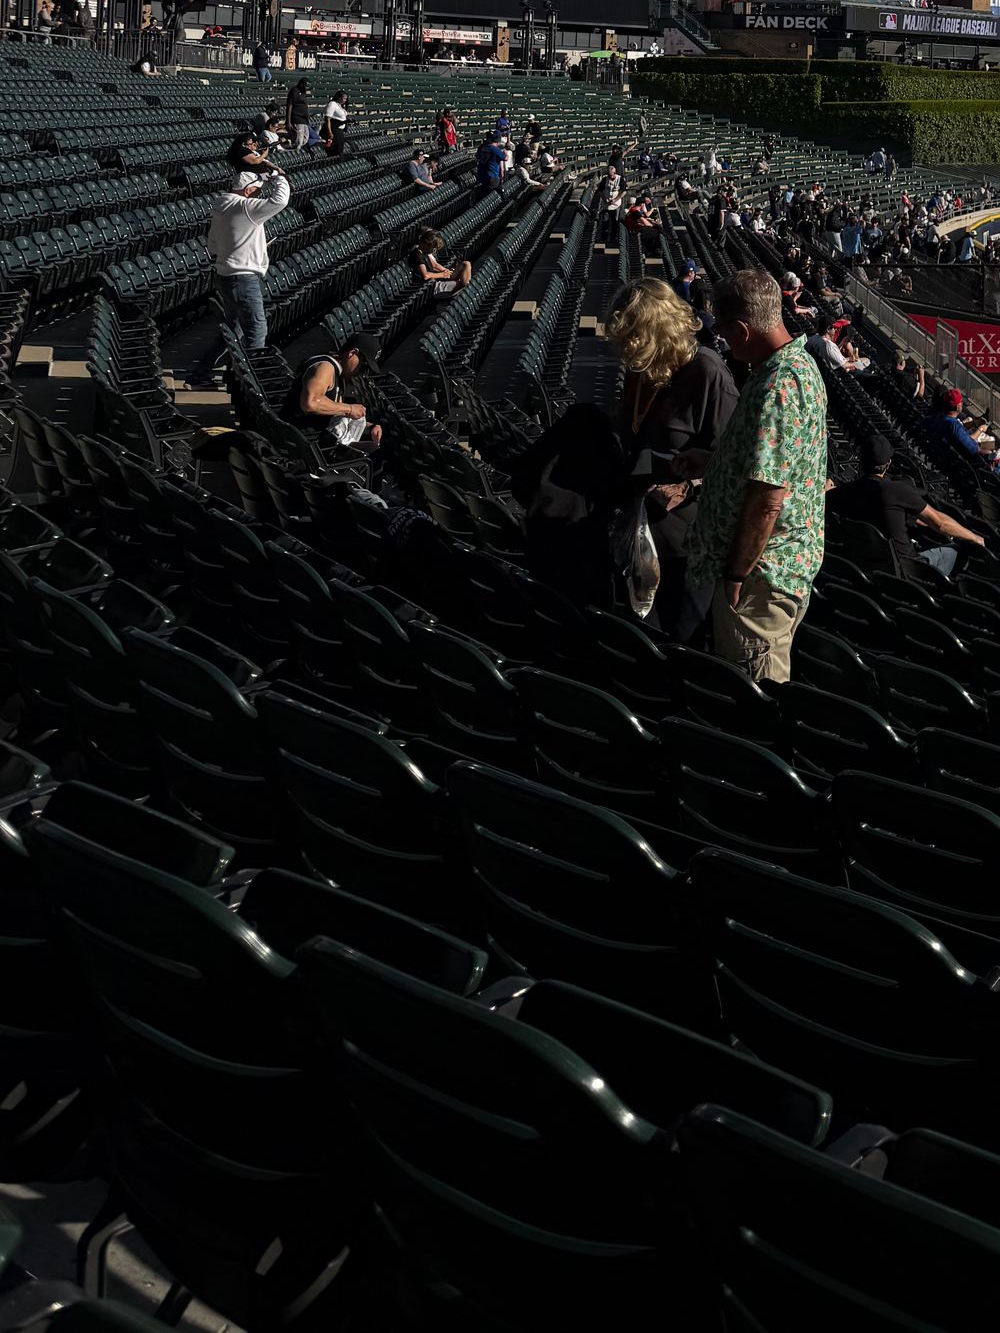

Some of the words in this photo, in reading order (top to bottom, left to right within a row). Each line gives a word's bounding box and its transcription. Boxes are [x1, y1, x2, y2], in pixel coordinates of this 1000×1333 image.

[745, 16, 778, 29] FAN
[783, 16, 829, 30] DECK
[902, 14, 931, 32] MAJOR
[931, 17, 961, 34] LEAGUE
[961, 19, 998, 37] BASEBALL
